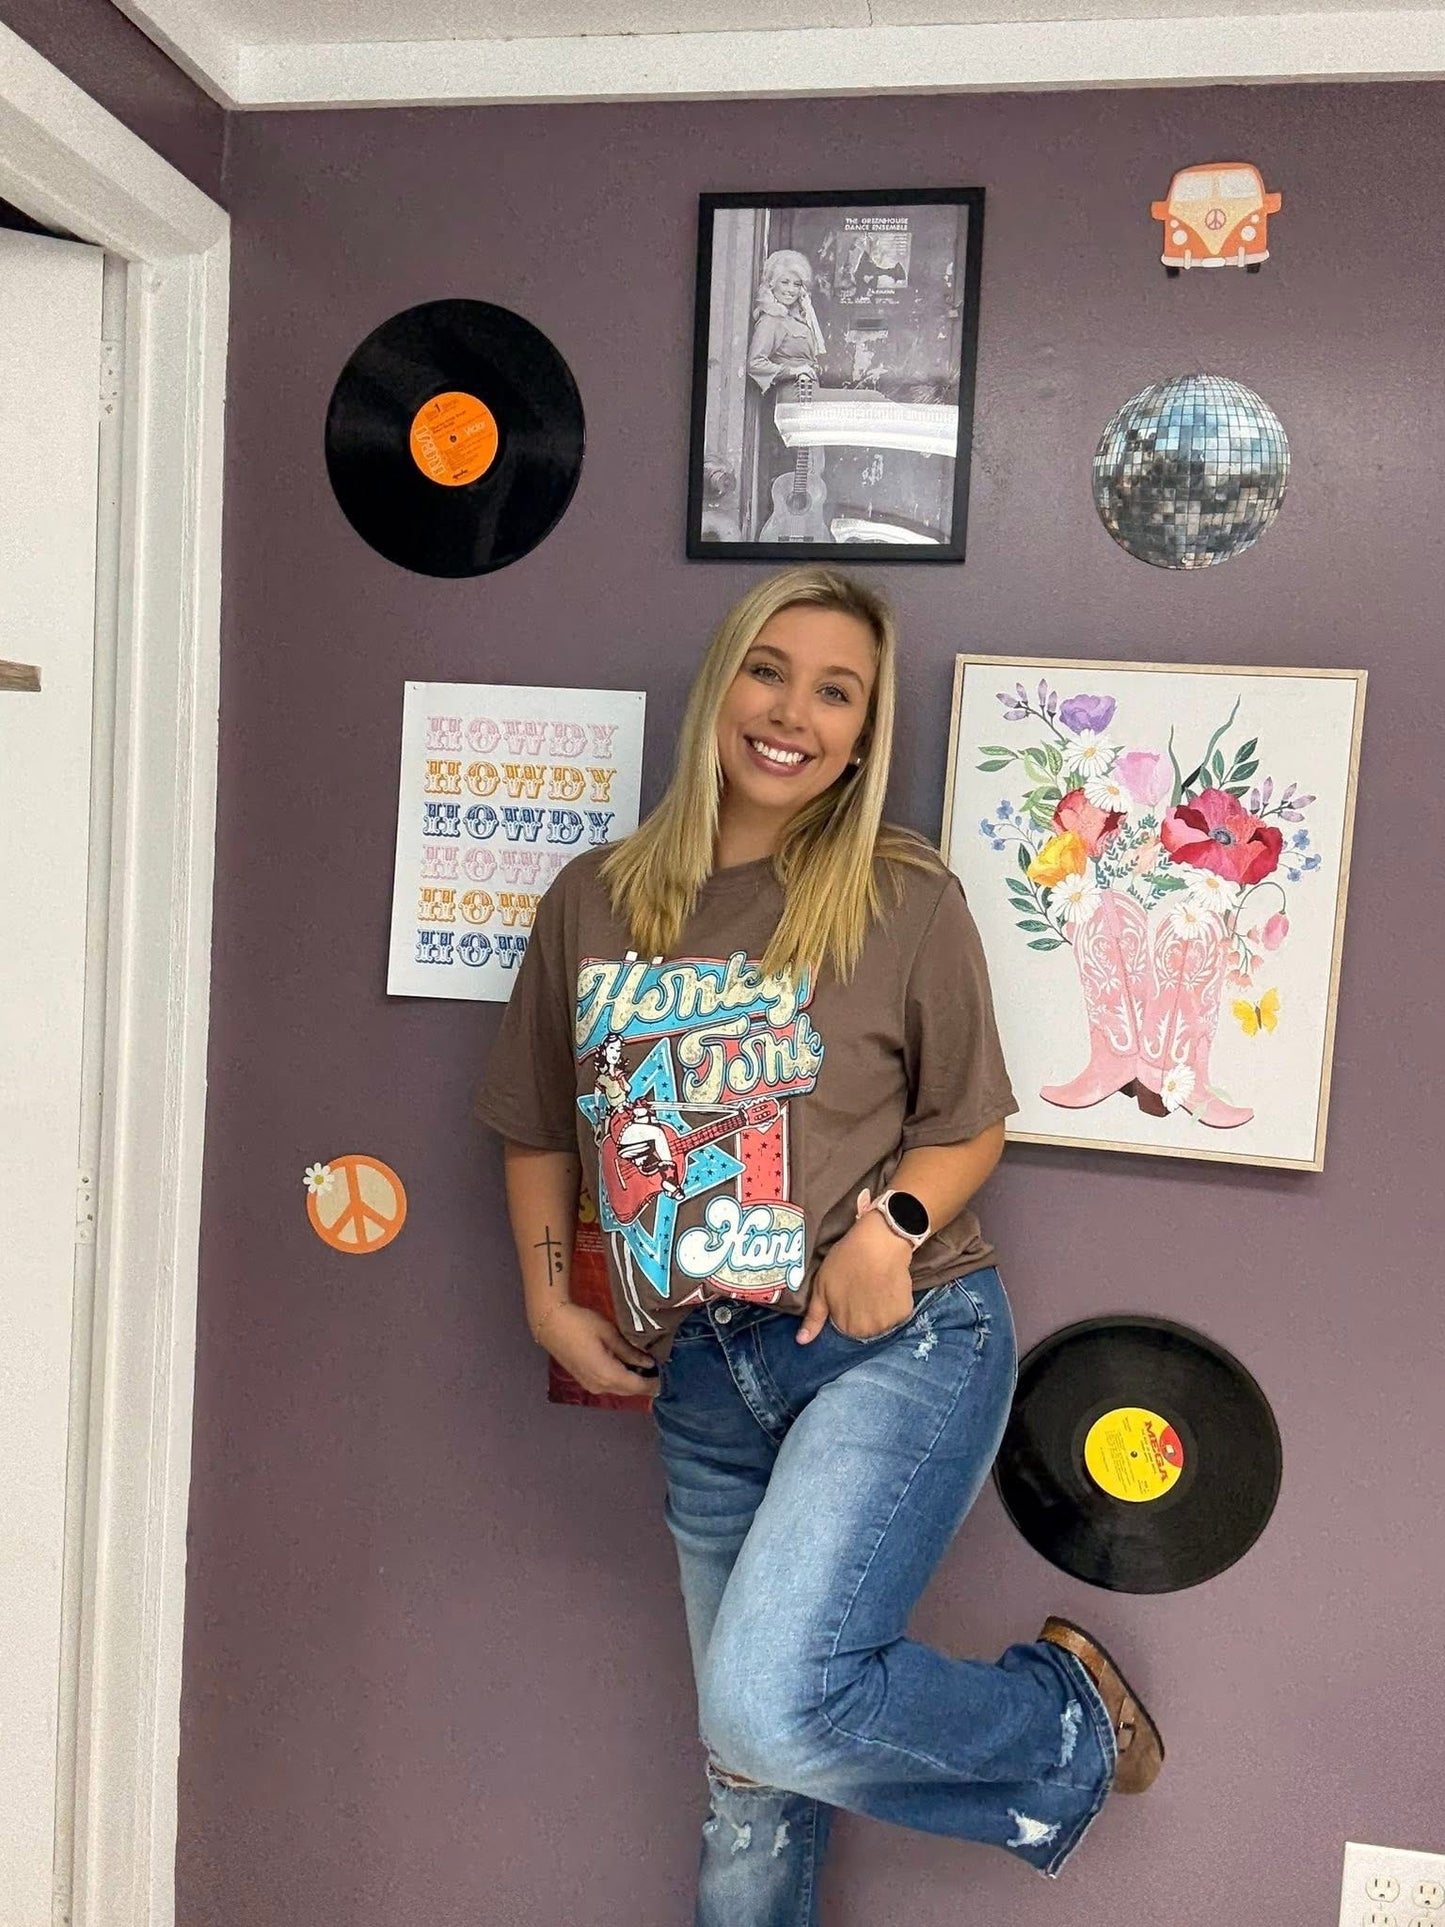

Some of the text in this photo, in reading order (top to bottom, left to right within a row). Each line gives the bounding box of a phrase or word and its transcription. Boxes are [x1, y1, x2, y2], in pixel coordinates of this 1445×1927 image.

[425, 716, 619, 758] HOWDY
[423, 759, 617, 803] HOWDY
[422, 802, 616, 845] HOWDY
[420, 845, 570, 885] HOW
[417, 886, 542, 927] HOW
[414, 928, 528, 969] HOW
[575, 950, 800, 1049] Honky
[677, 1013, 824, 1104] Tonk
[1144, 1420, 1168, 1482] MEGA
